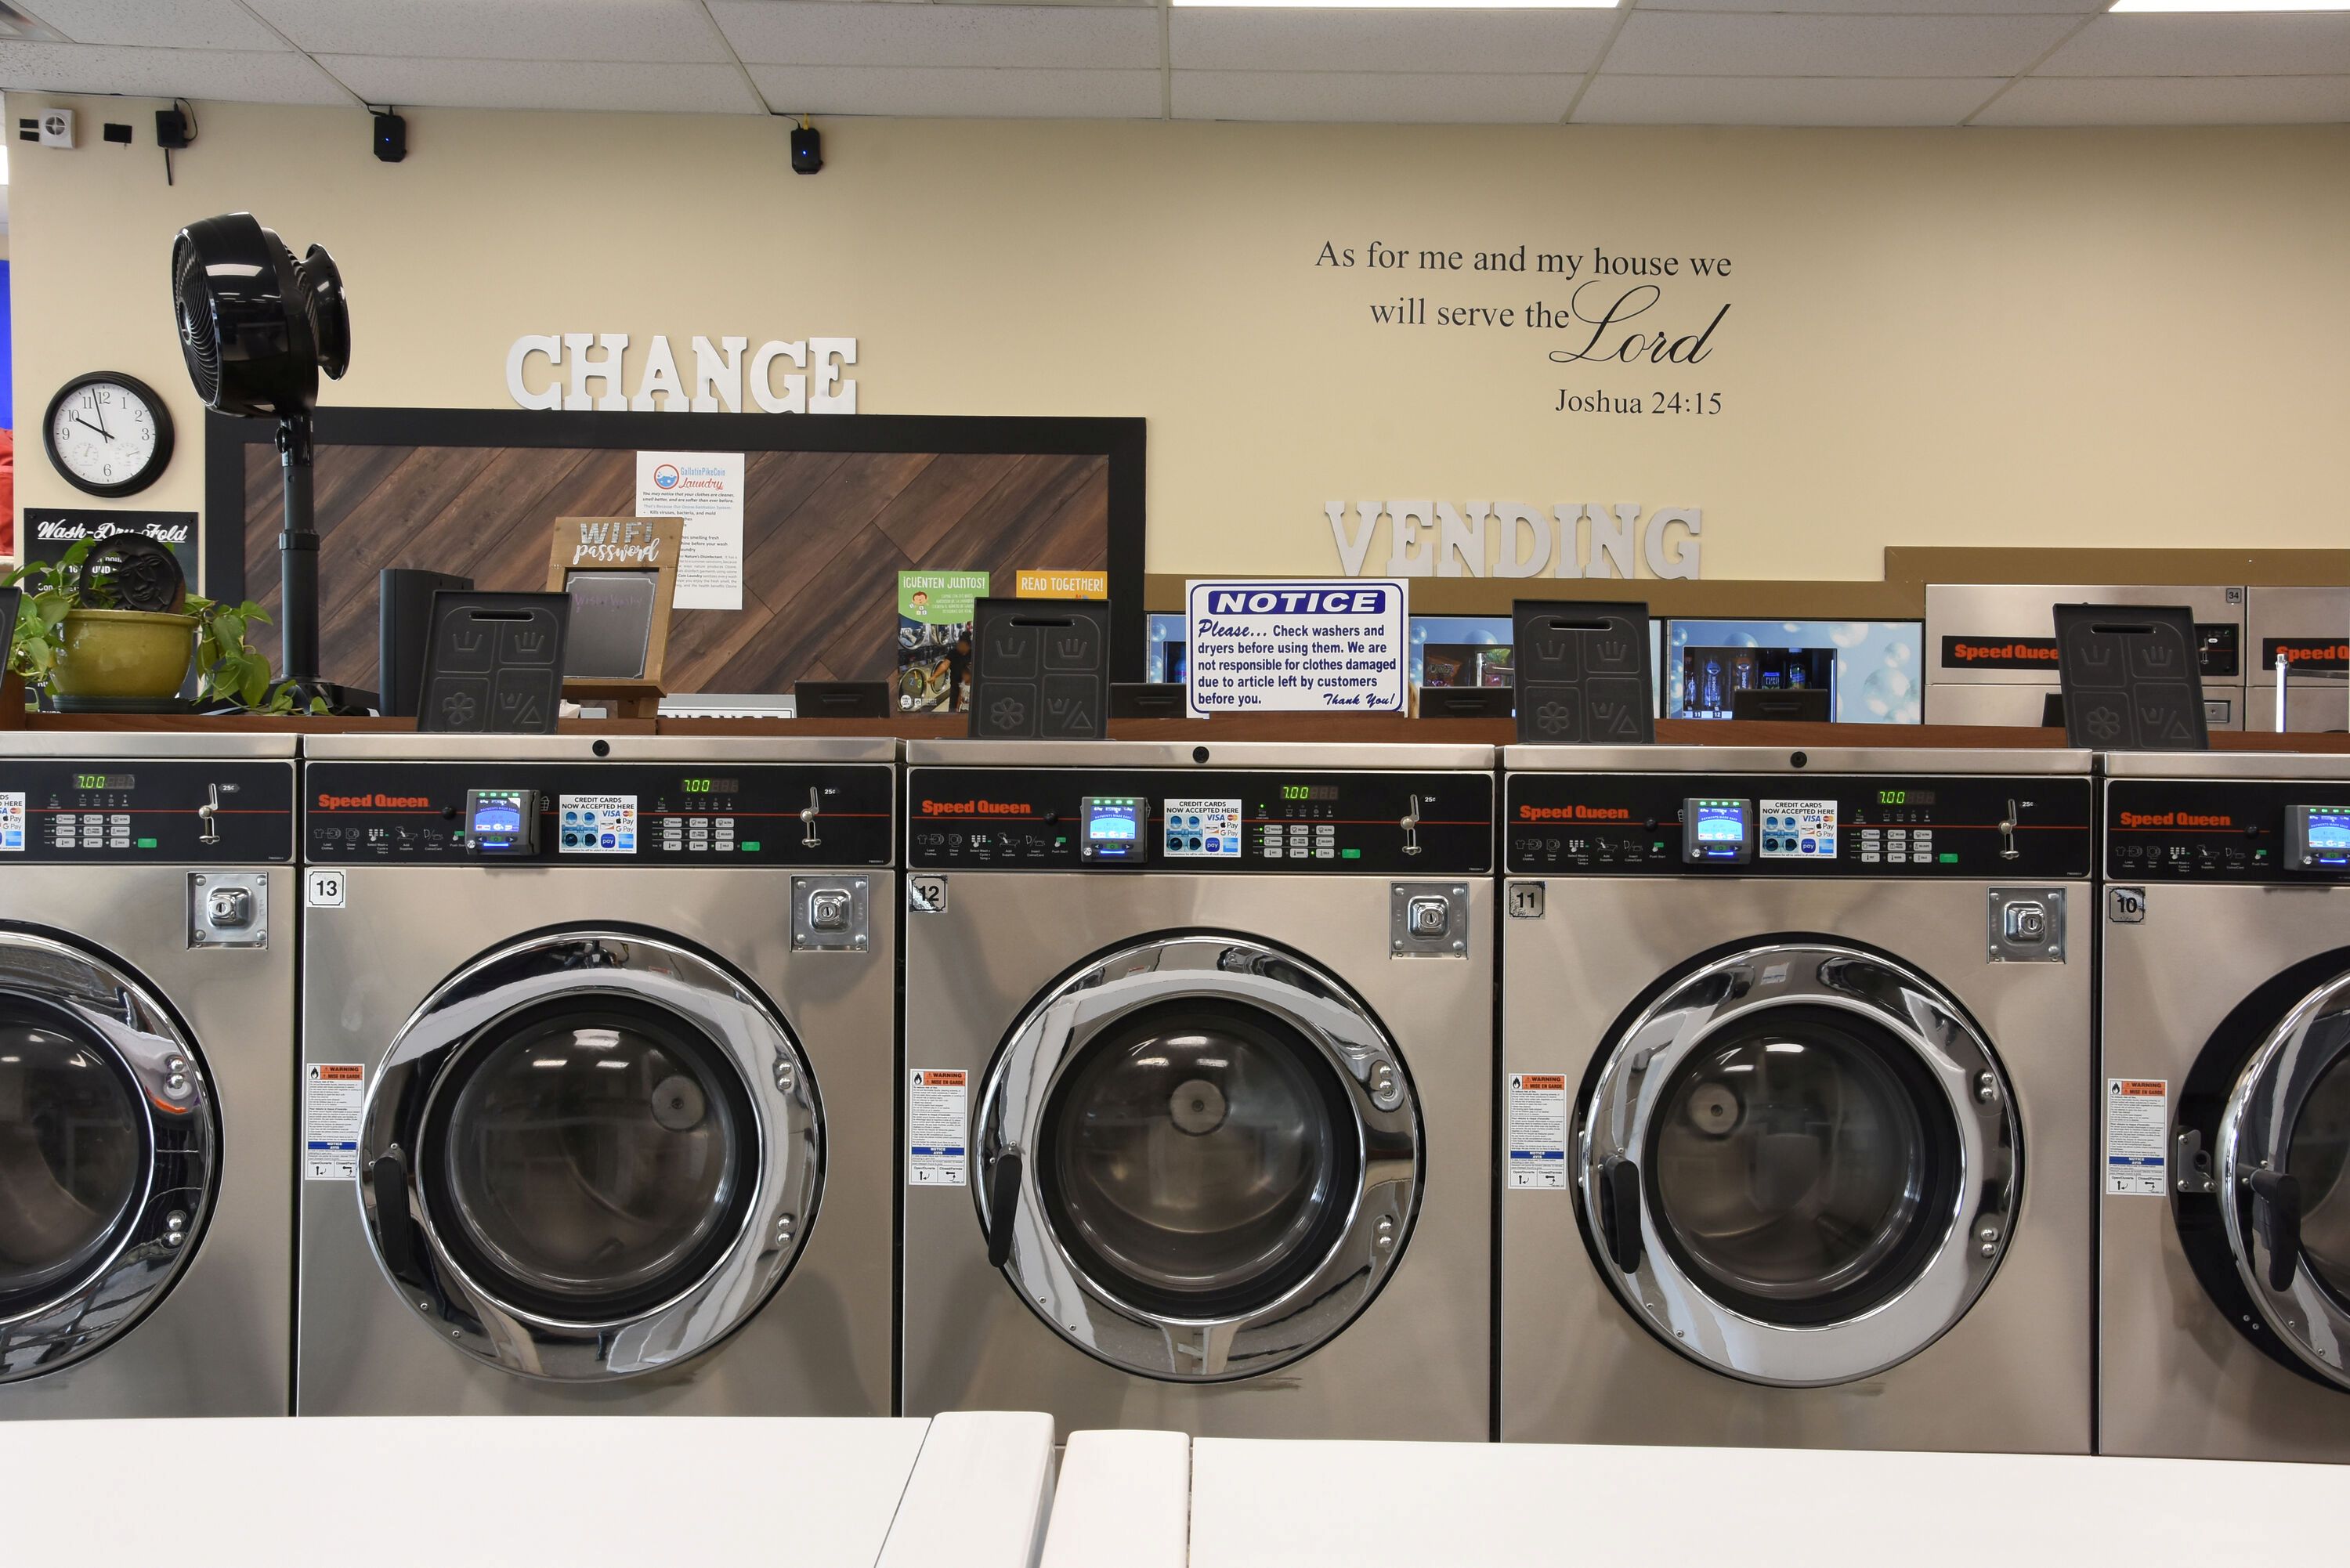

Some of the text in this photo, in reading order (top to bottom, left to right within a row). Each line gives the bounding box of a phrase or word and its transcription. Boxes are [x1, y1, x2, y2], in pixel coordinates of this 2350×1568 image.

[1314, 240, 1732, 281] As for me and my house we
[1370, 280, 1732, 364] will serve the Lord
[505, 333, 857, 415] CHANGE
[83, 396, 92, 409] 11
[99, 392, 110, 404] 12
[122, 397, 127, 409] 1
[1555, 389, 1723, 416] Joshua 24:15
[68, 410, 79, 422] 10
[135, 410, 143, 422] 2
[62, 428, 70, 440] 9
[142, 428, 150, 441] 3
[103, 464, 111, 476] 6
[678, 478, 724, 490] Laundry
[580, 522, 653, 544] WIFI
[1324, 500, 1701, 580] VENDING
[573, 538, 660, 565] password
[902, 576, 985, 590] ¡CUENTEN JUNTOS!
[1021, 577, 1104, 592] READ TOGETHER!
[1216, 593, 1378, 612] NOTICE
[2229, 591, 2239, 600] 34
[1198, 619, 1384, 638] Please... Check washers and
[1198, 641, 1387, 656] dryers before using them. We are
[1954, 644, 2059, 661] Speed Quee
[1198, 658, 1396, 673] not responsible for clothes damaged
[913, 670, 918, 679] 1
[1198, 675, 1377, 690] due to article left by customers
[1198, 692, 1261, 706] before you.
[1323, 693, 1396, 708] Thank You!
[79, 776, 105, 789] 7.00
[684, 780, 710, 792] 7.00
[1283, 787, 1308, 799] 7.00
[1880, 791, 1905, 804] 7.00
[318, 793, 429, 810] Speed Queen
[921, 800, 1032, 816] Speed Queen
[1520, 804, 1630, 821] Speed Queen
[2120, 811, 2231, 828] Speed Queen
[316, 880, 337, 897] 13
[920, 886, 939, 901] 12
[1517, 892, 1535, 909] 11
[2117, 897, 2137, 913] 10
